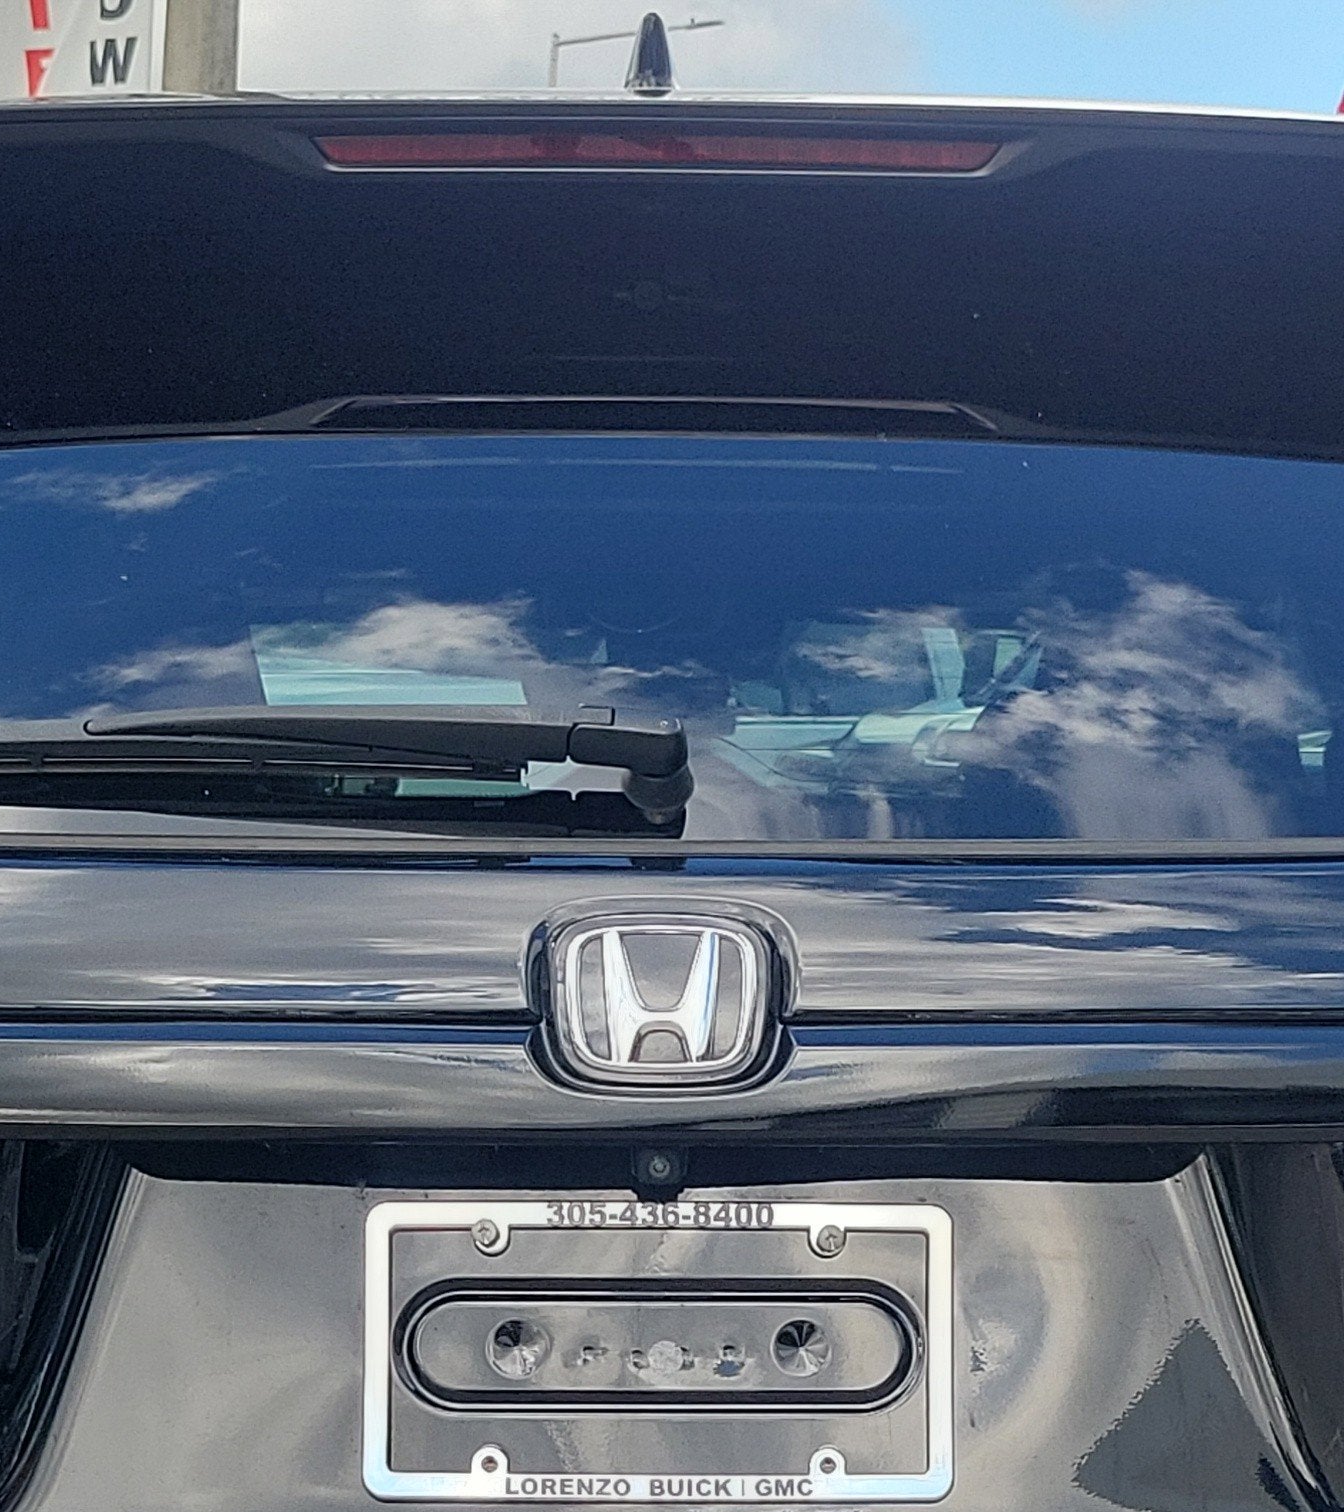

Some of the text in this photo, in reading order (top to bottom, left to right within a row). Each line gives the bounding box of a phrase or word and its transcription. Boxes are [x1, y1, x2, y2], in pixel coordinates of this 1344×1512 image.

[546, 1201, 775, 1228] 305-436-8400
[505, 1477, 814, 1497] LORENZO BUICK GMC
